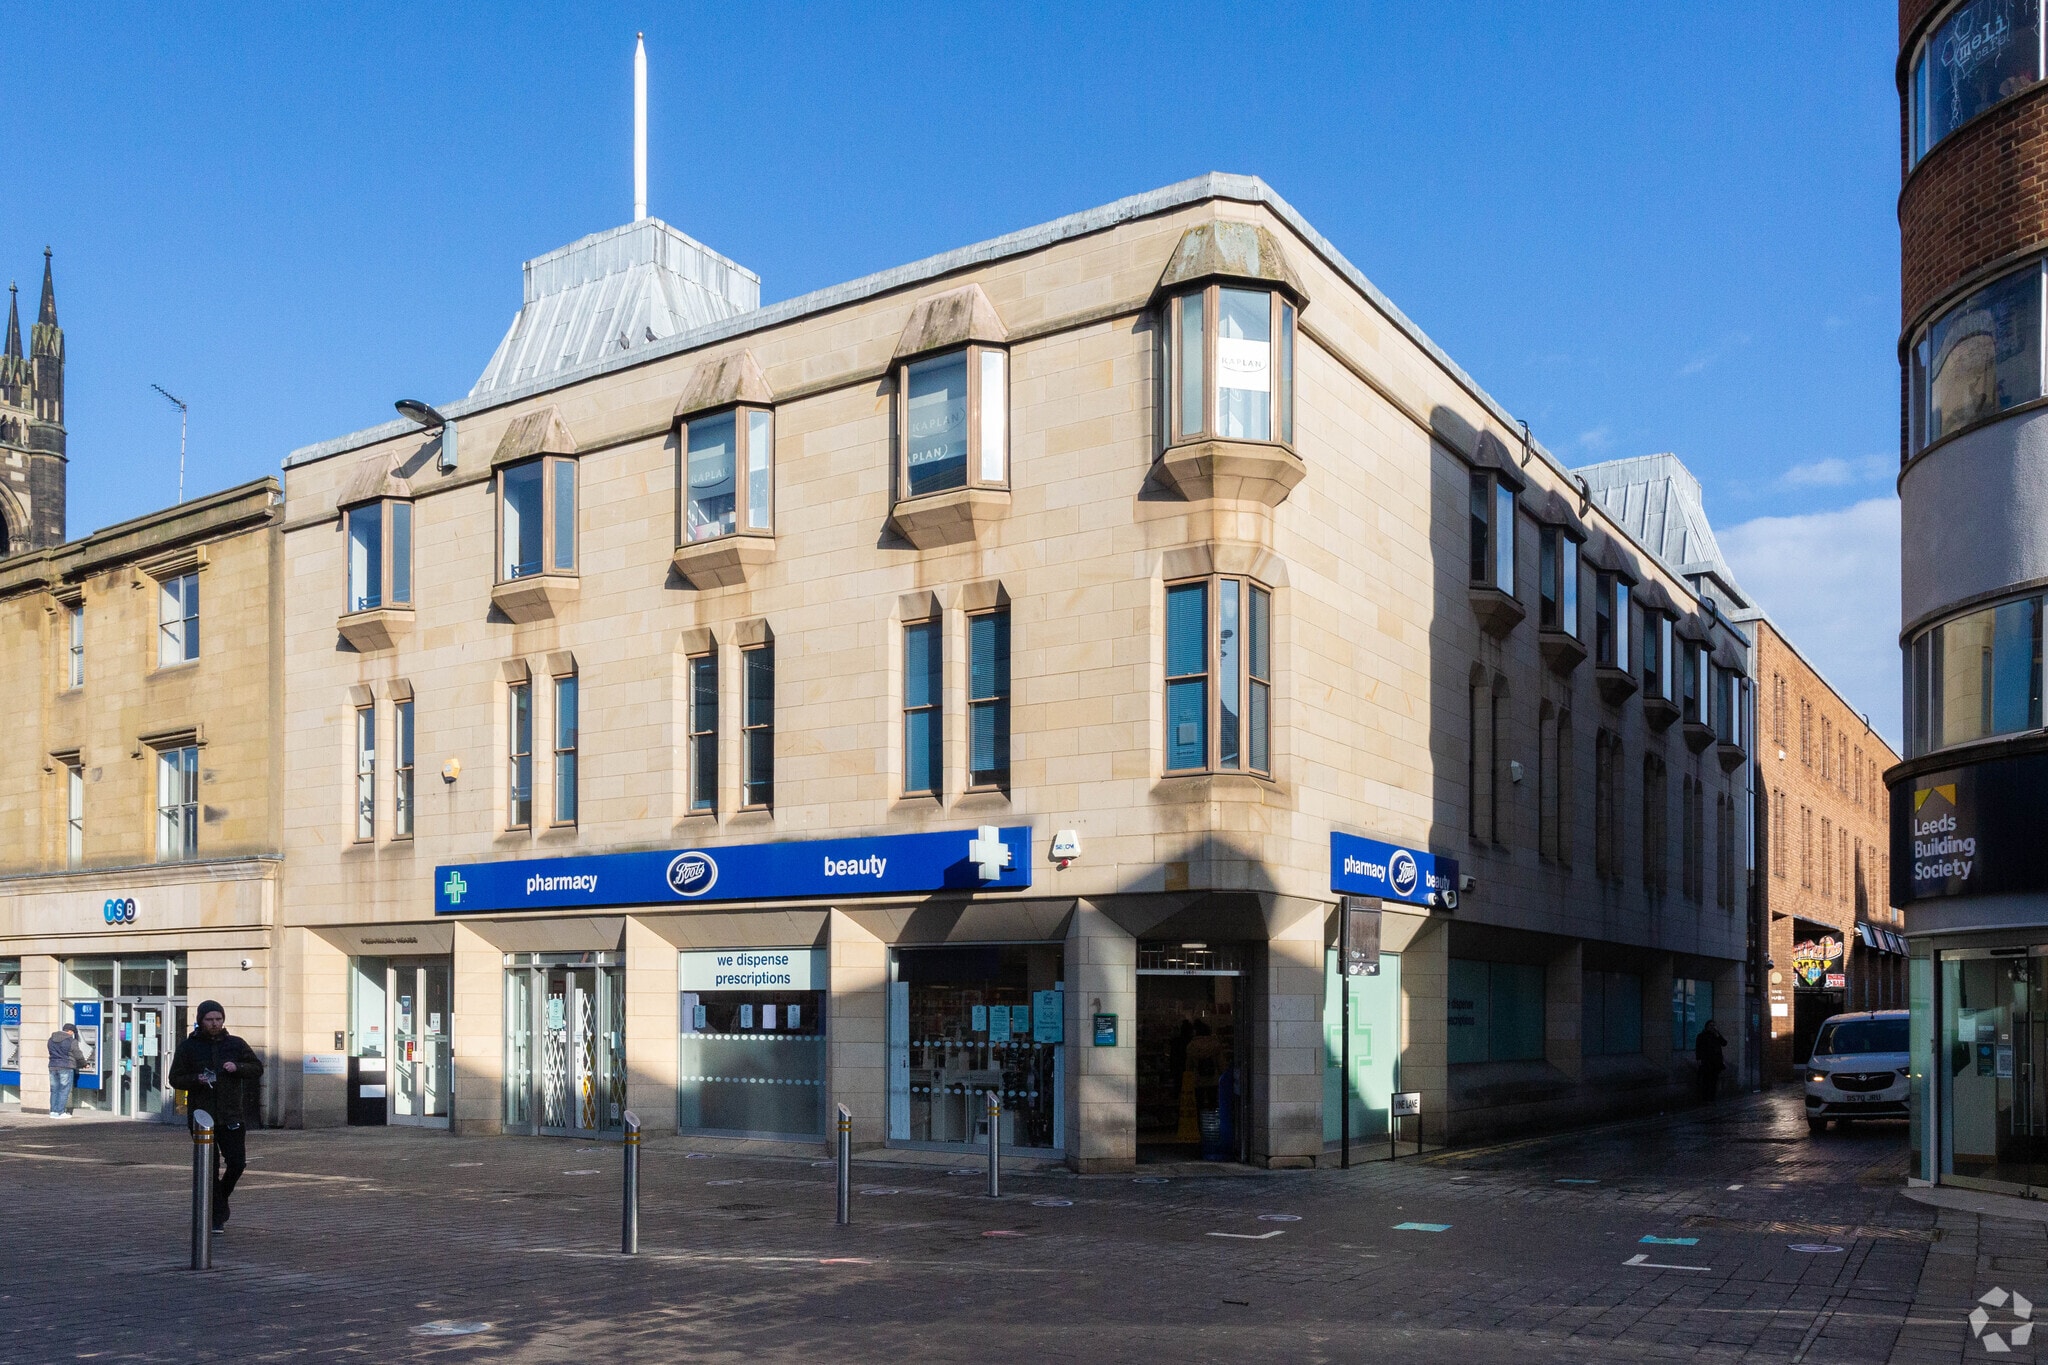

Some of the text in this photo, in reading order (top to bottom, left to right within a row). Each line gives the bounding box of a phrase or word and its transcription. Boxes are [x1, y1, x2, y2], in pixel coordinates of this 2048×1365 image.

[1960, 15, 2007, 60] meli
[1221, 357, 1262, 368] KAPLAN
[912, 413, 959, 433] KAPLAN
[908, 447, 941, 464] PLAN
[1914, 813, 1957, 836] Leeds
[1914, 835, 1976, 858] Building
[526, 854, 887, 895] pharmacy Boots beauty
[1344, 854, 1451, 892] pharmacy Boots beauty
[1914, 859, 1972, 880] Society
[717, 953, 789, 968] we dispense
[715, 971, 791, 987] prescriptions
[1406, 1098, 1418, 1109] LANE
